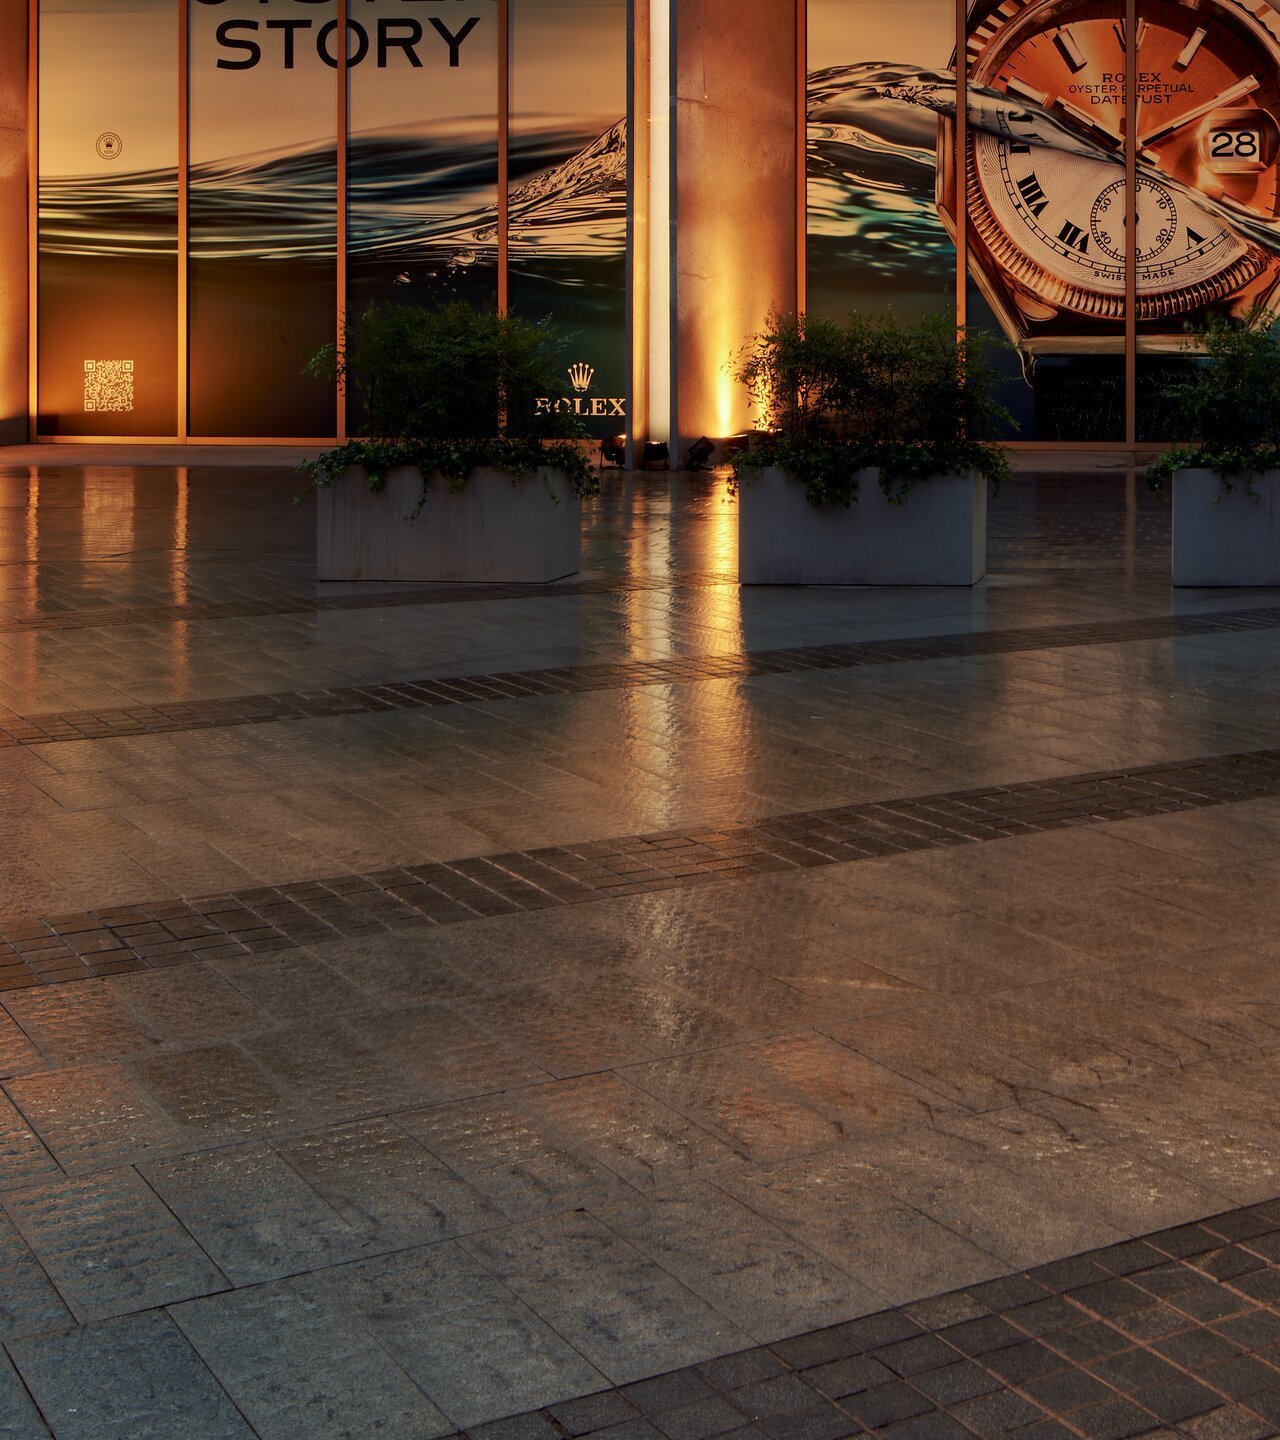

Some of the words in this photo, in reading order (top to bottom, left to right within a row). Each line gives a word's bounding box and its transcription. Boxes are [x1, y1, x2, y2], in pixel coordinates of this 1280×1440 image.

[215, 16, 481, 70] STORY
[1102, 72, 1162, 83] ROEX
[1068, 84, 1117, 94] OYSTER
[1122, 84, 1195, 94] PRPETUAL
[1211, 131, 1257, 158] 28
[1099, 197, 1112, 213] 50
[1155, 197, 1168, 210] 10
[1099, 230, 1112, 245] 40
[1155, 228, 1169, 244] 20
[1142, 268, 1175, 281] MADE
